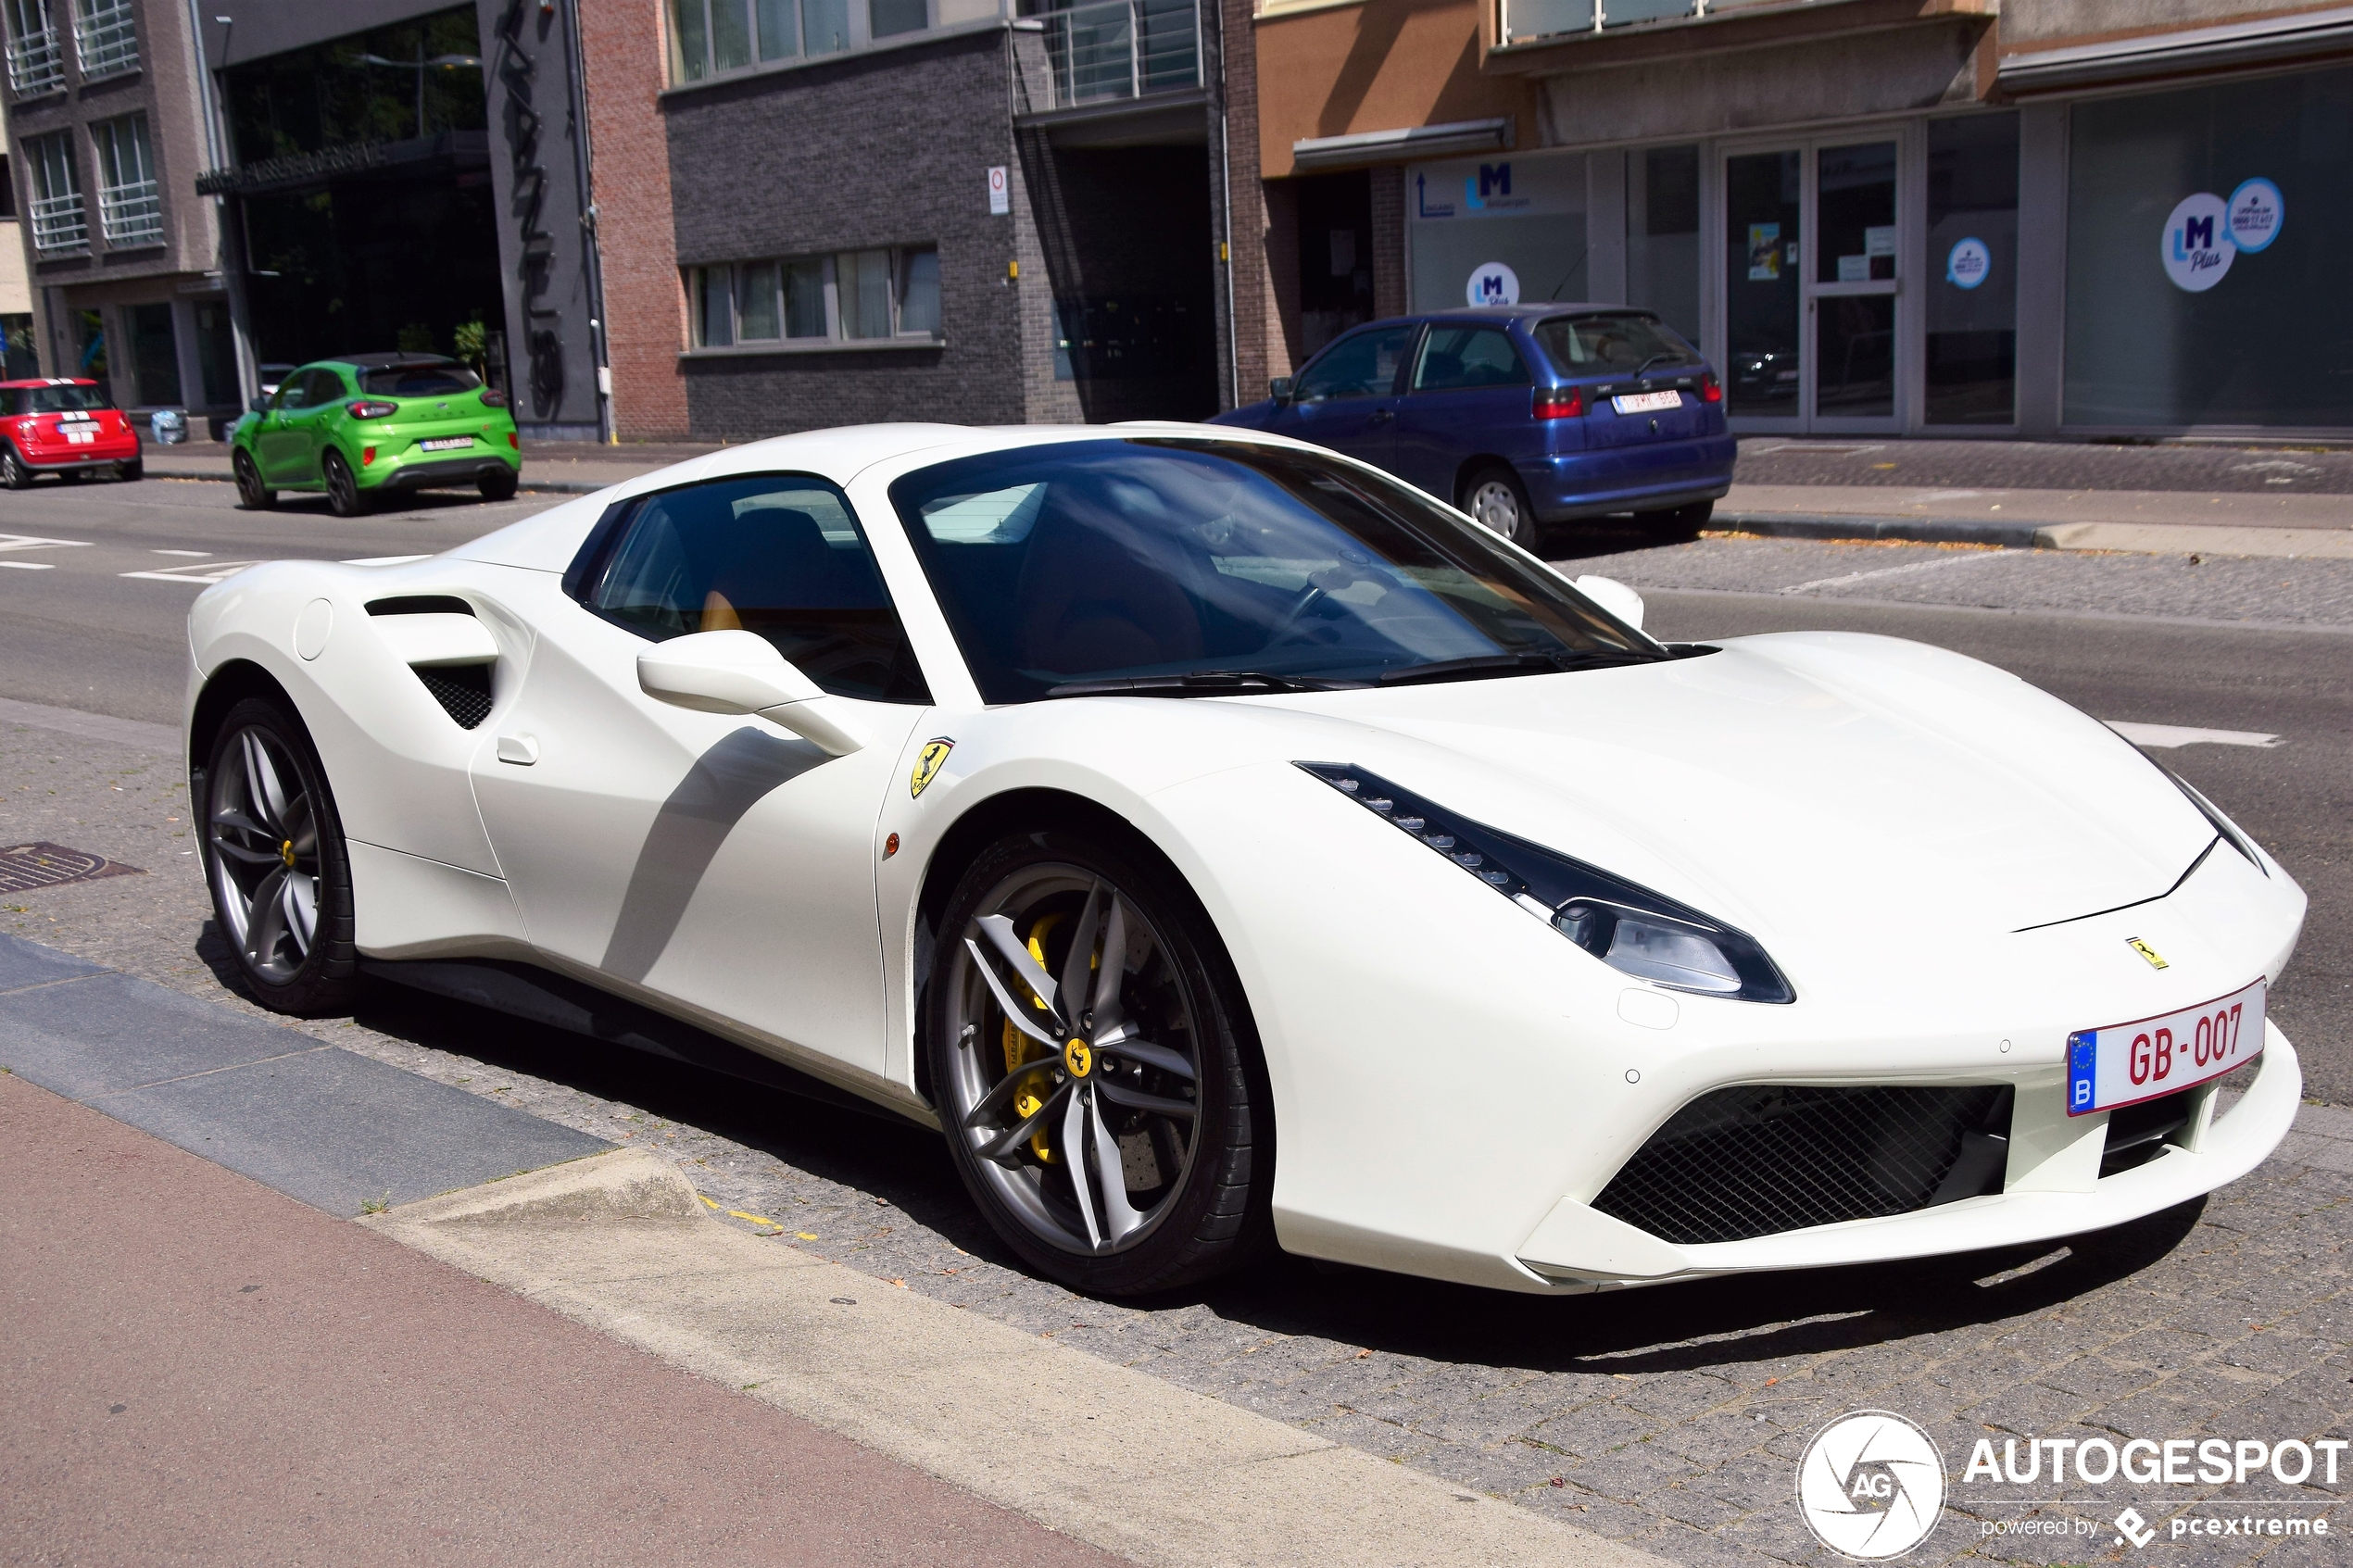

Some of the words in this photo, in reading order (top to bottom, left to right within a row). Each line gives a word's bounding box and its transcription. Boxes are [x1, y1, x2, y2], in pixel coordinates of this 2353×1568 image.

[2173, 214, 2215, 262] LM
[2191, 250, 2221, 272] Plus
[1475, 275, 1503, 304] LM
[2130, 1001, 2243, 1086] GB-007
[2075, 1079, 2091, 1105] B
